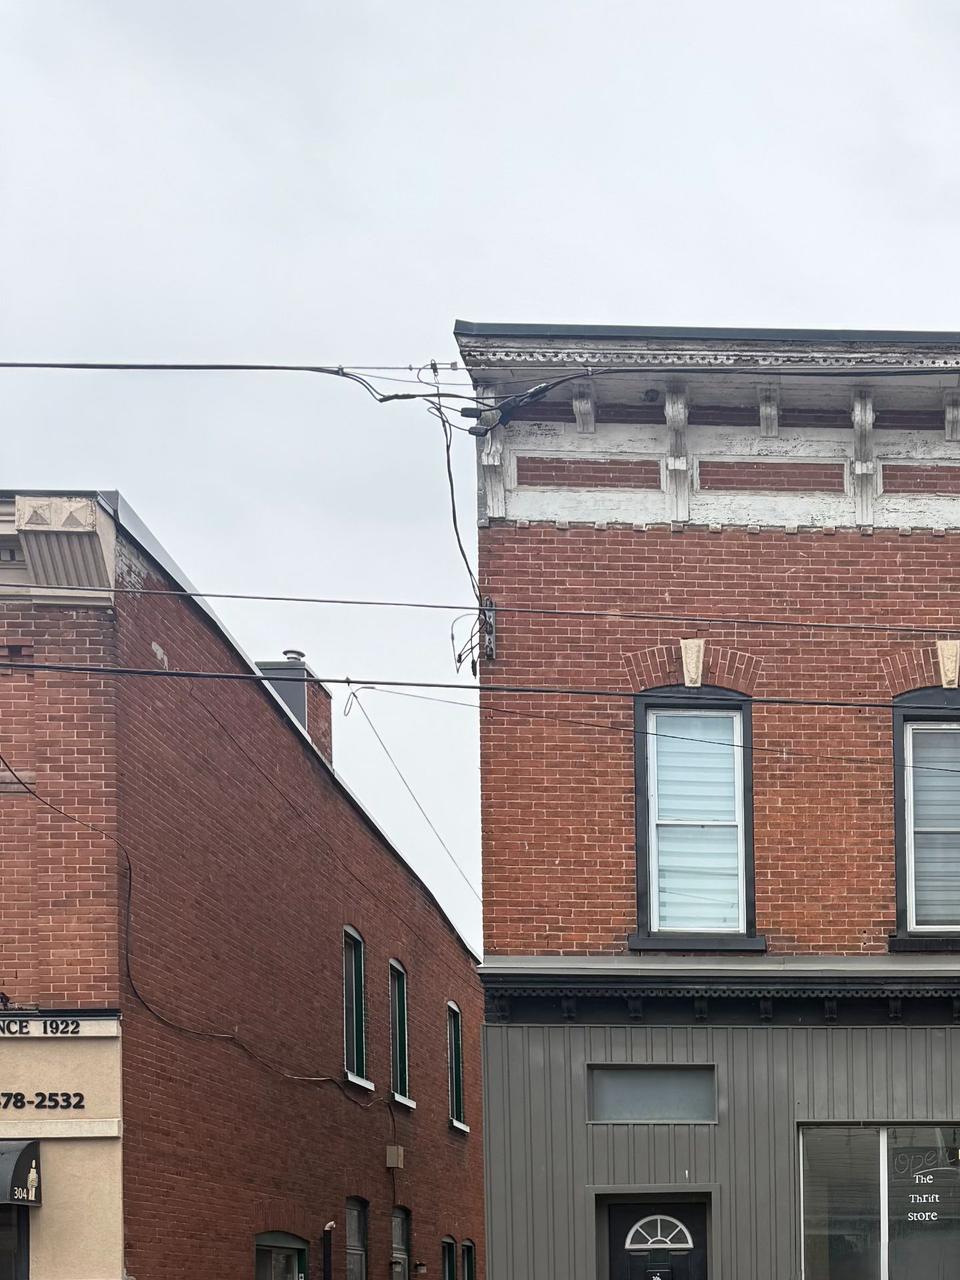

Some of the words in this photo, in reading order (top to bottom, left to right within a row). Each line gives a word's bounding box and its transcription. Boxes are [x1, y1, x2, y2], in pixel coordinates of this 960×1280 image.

[42, 1019, 80, 1035] 1922
[0, 1092, 85, 1109] 78-2532
[913, 1174, 934, 1184] The
[13, 1186, 28, 1200] 304
[908, 1194, 940, 1203] Thrift
